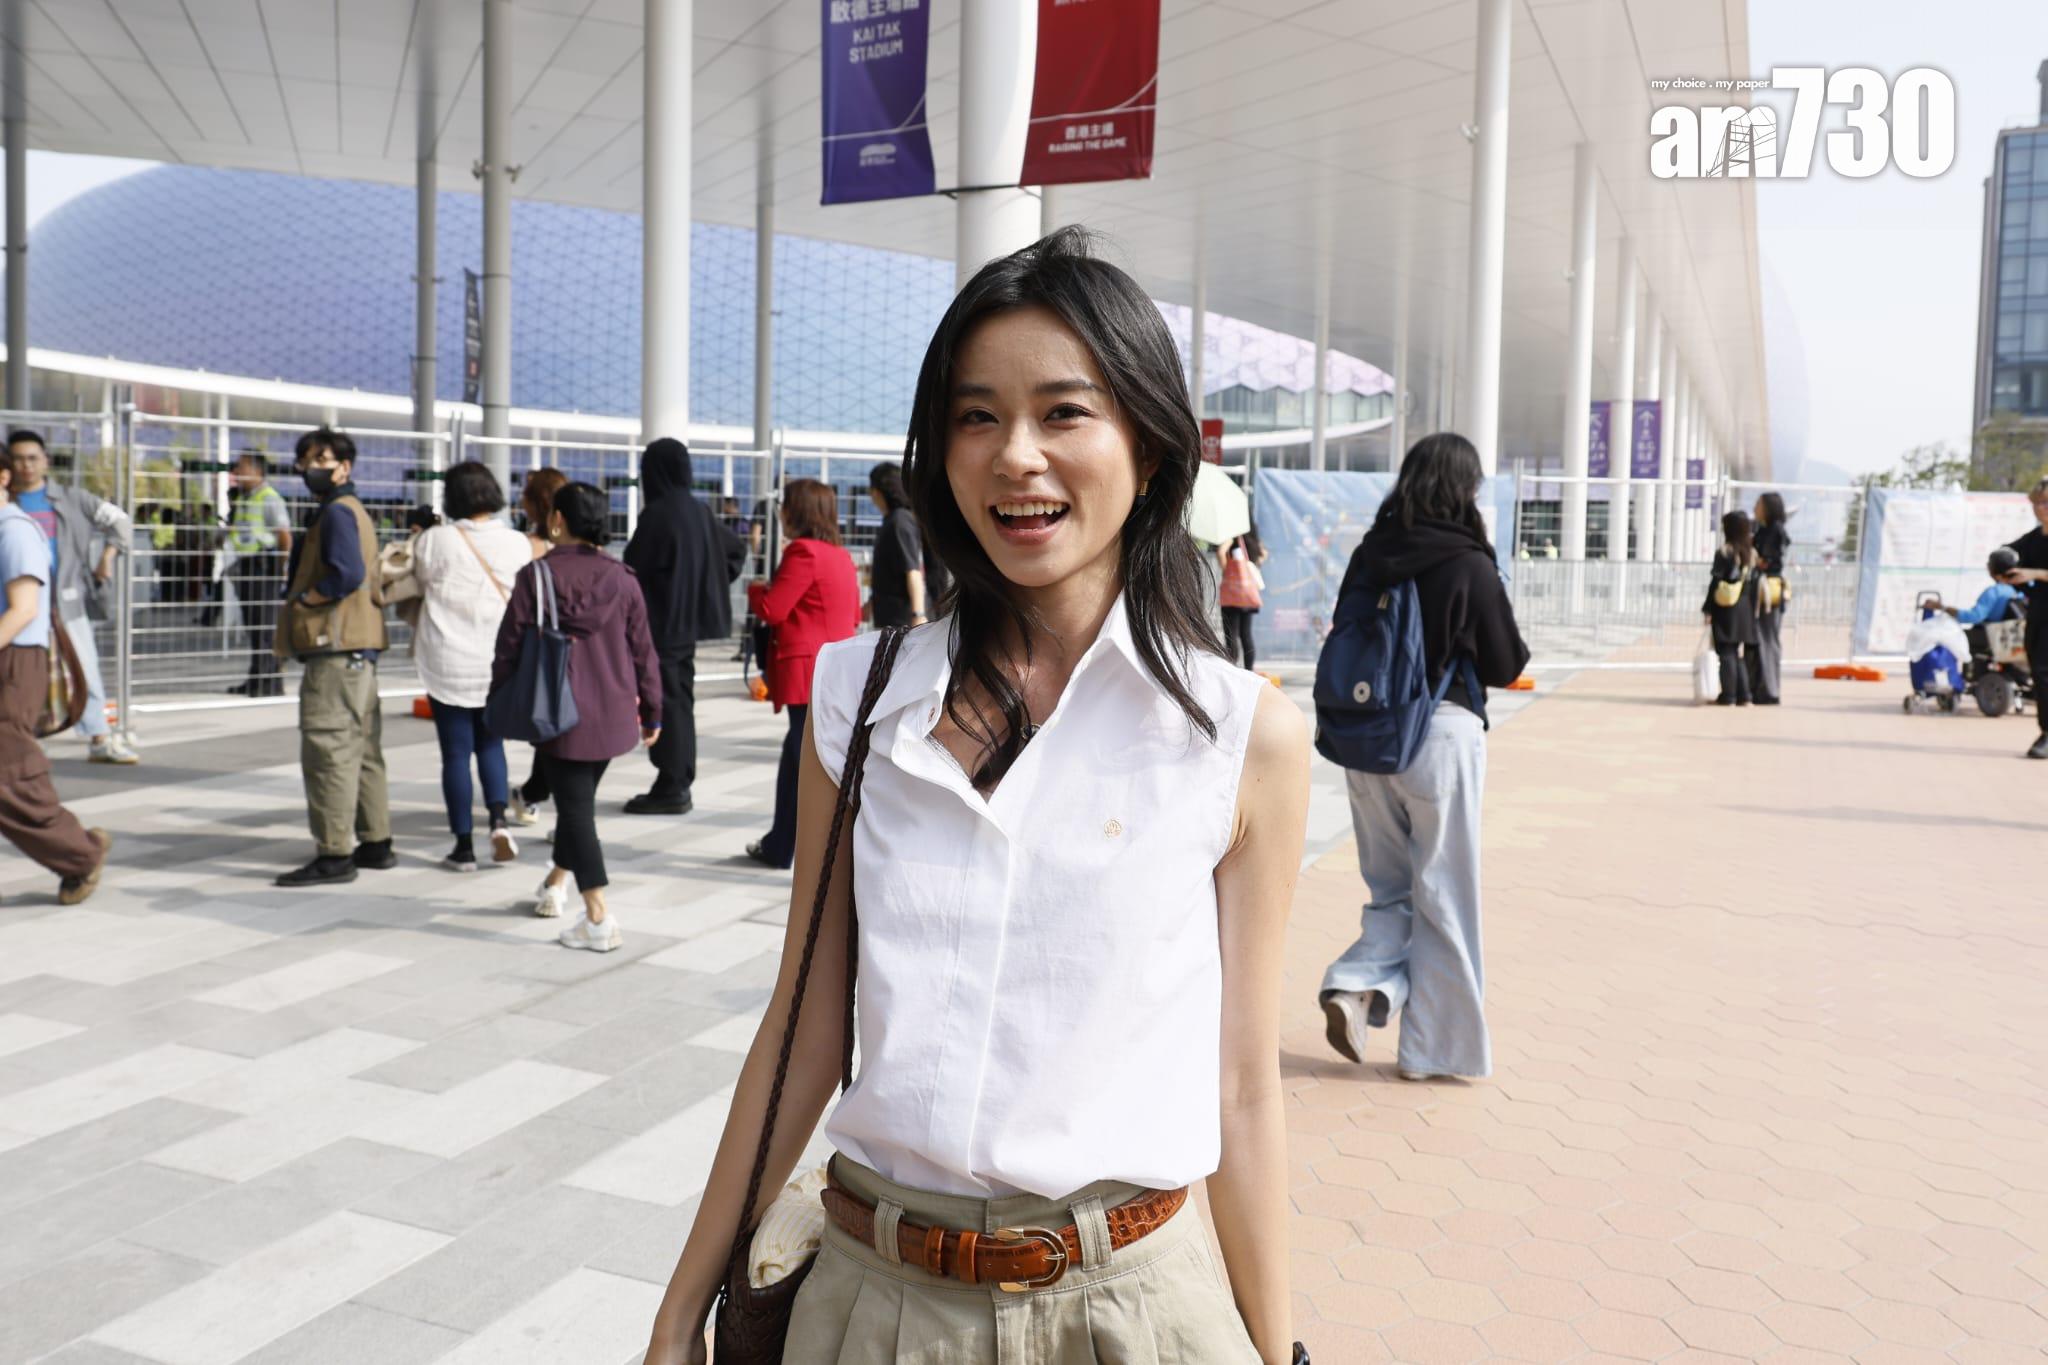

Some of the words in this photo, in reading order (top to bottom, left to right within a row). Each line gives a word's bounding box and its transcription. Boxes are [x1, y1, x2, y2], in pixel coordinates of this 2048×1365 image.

[853, 26, 875, 45] KAI
[877, 20, 901, 39] TAK
[849, 39, 904, 64] STADIUM
[1048, 142, 1083, 154] RAISING
[1085, 140, 1101, 151] THE
[1102, 136, 1127, 149] GAME
